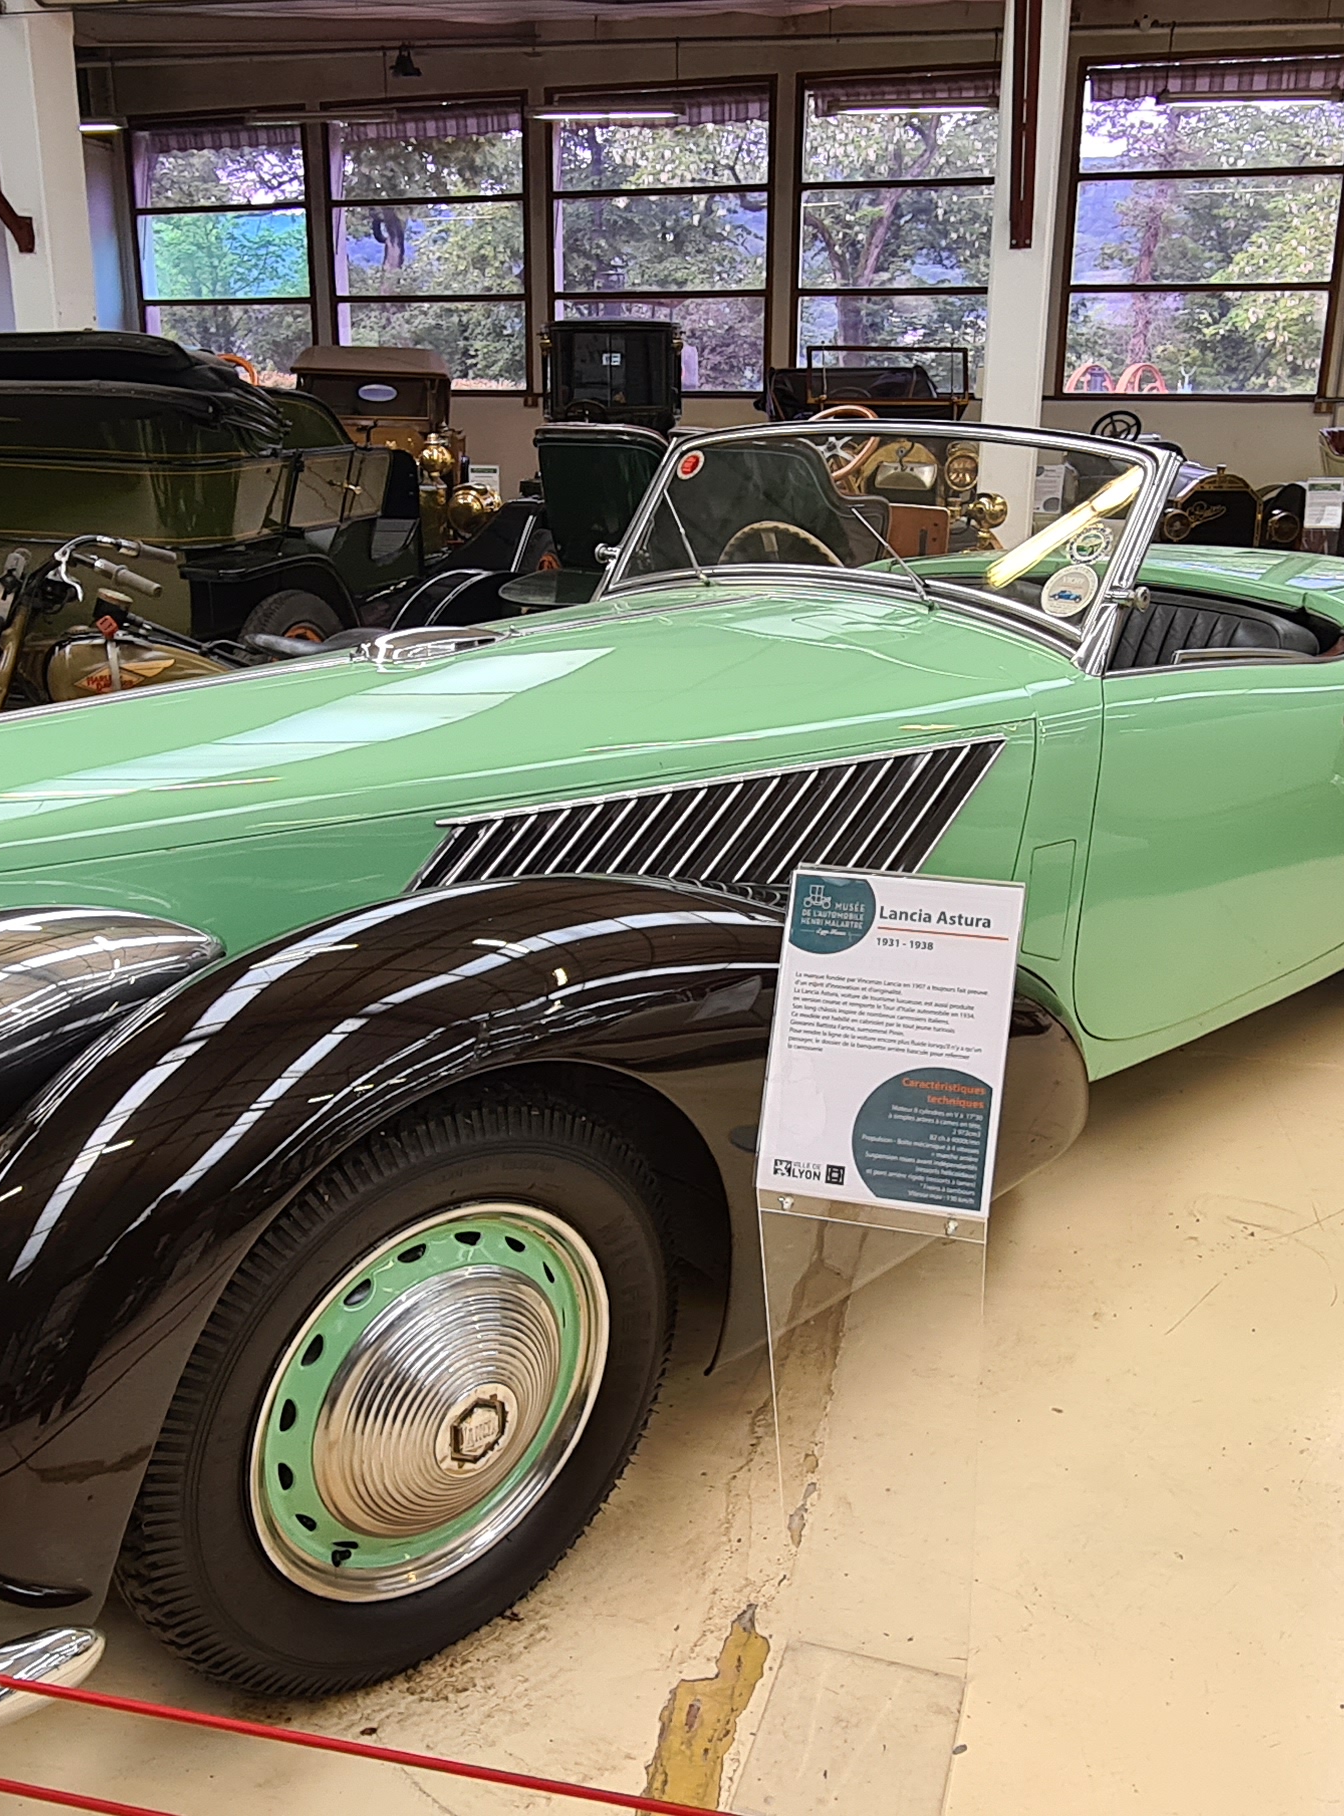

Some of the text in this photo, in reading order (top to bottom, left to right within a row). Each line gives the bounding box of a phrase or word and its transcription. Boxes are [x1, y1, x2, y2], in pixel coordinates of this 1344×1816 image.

[835, 902, 866, 912] MUSÉE
[879, 906, 991, 928] Lancia Astura
[876, 937, 899, 947] 1931
[910, 940, 933, 950] 1938
[902, 1077, 986, 1095] Caractéristiques
[927, 1094, 984, 1108] techniques
[792, 1168, 821, 1181] LYON
